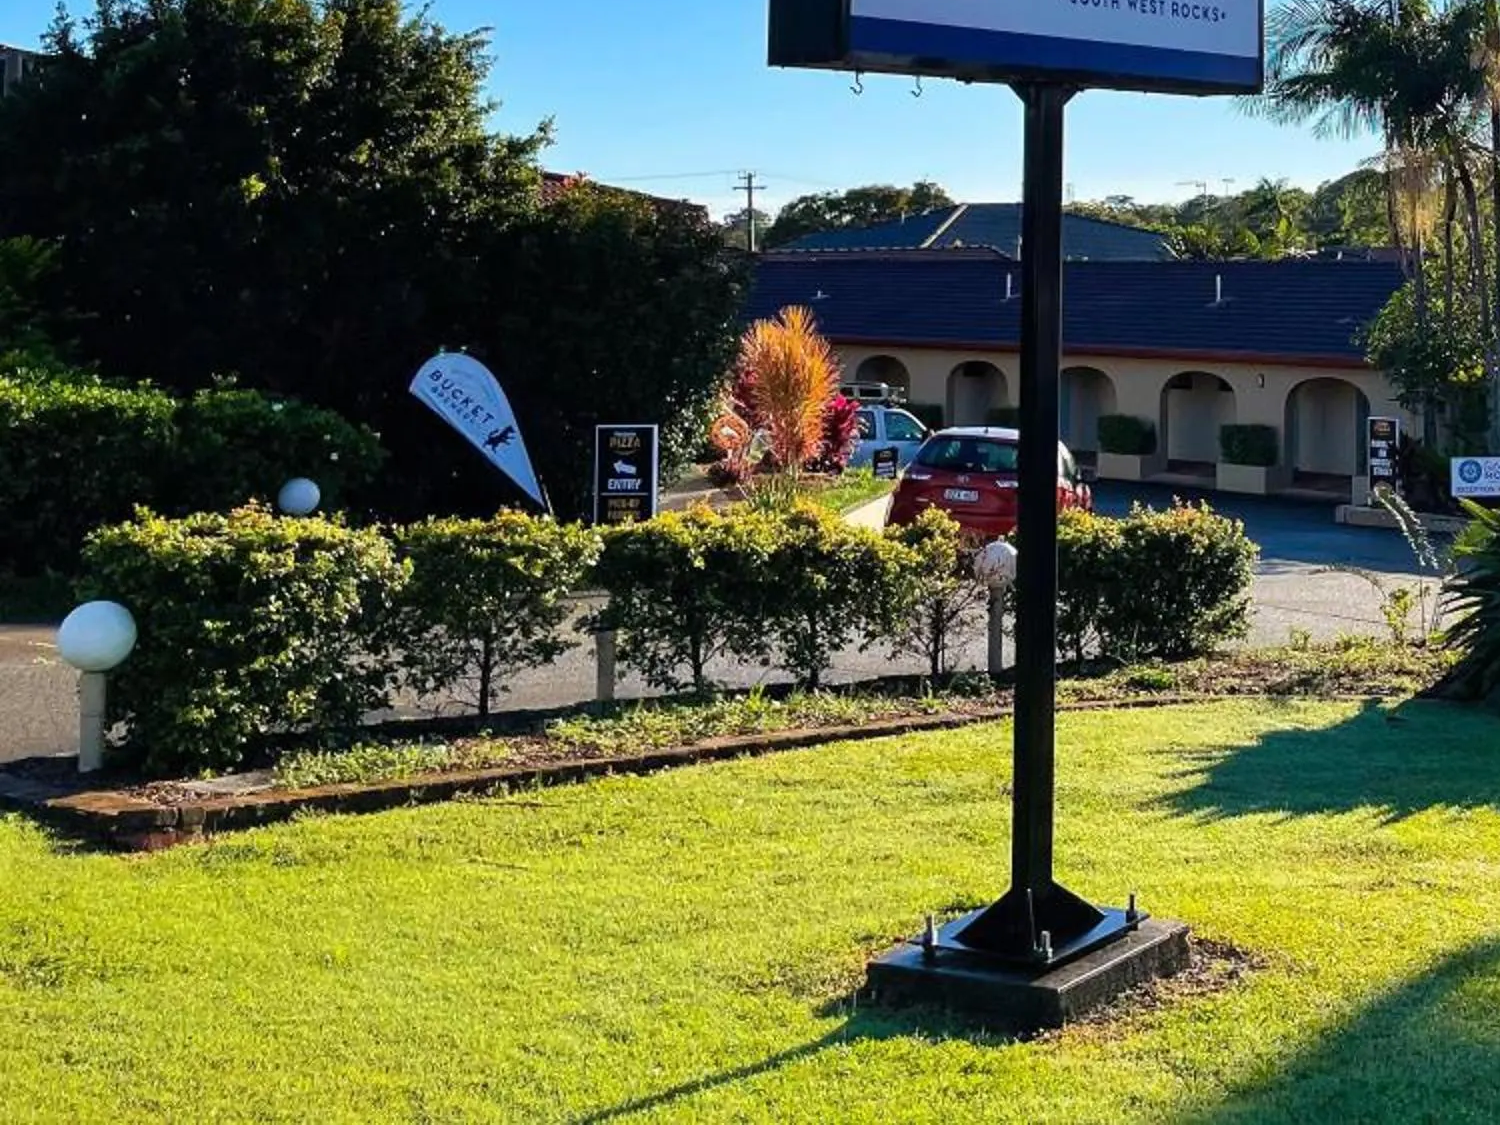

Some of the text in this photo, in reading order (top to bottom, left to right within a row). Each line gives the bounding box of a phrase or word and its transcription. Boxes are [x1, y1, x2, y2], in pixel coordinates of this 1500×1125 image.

[1171, 1, 1219, 22] ROCKS
[429, 370, 494, 424] BUCKET
[608, 478, 641, 490] ENTRY
